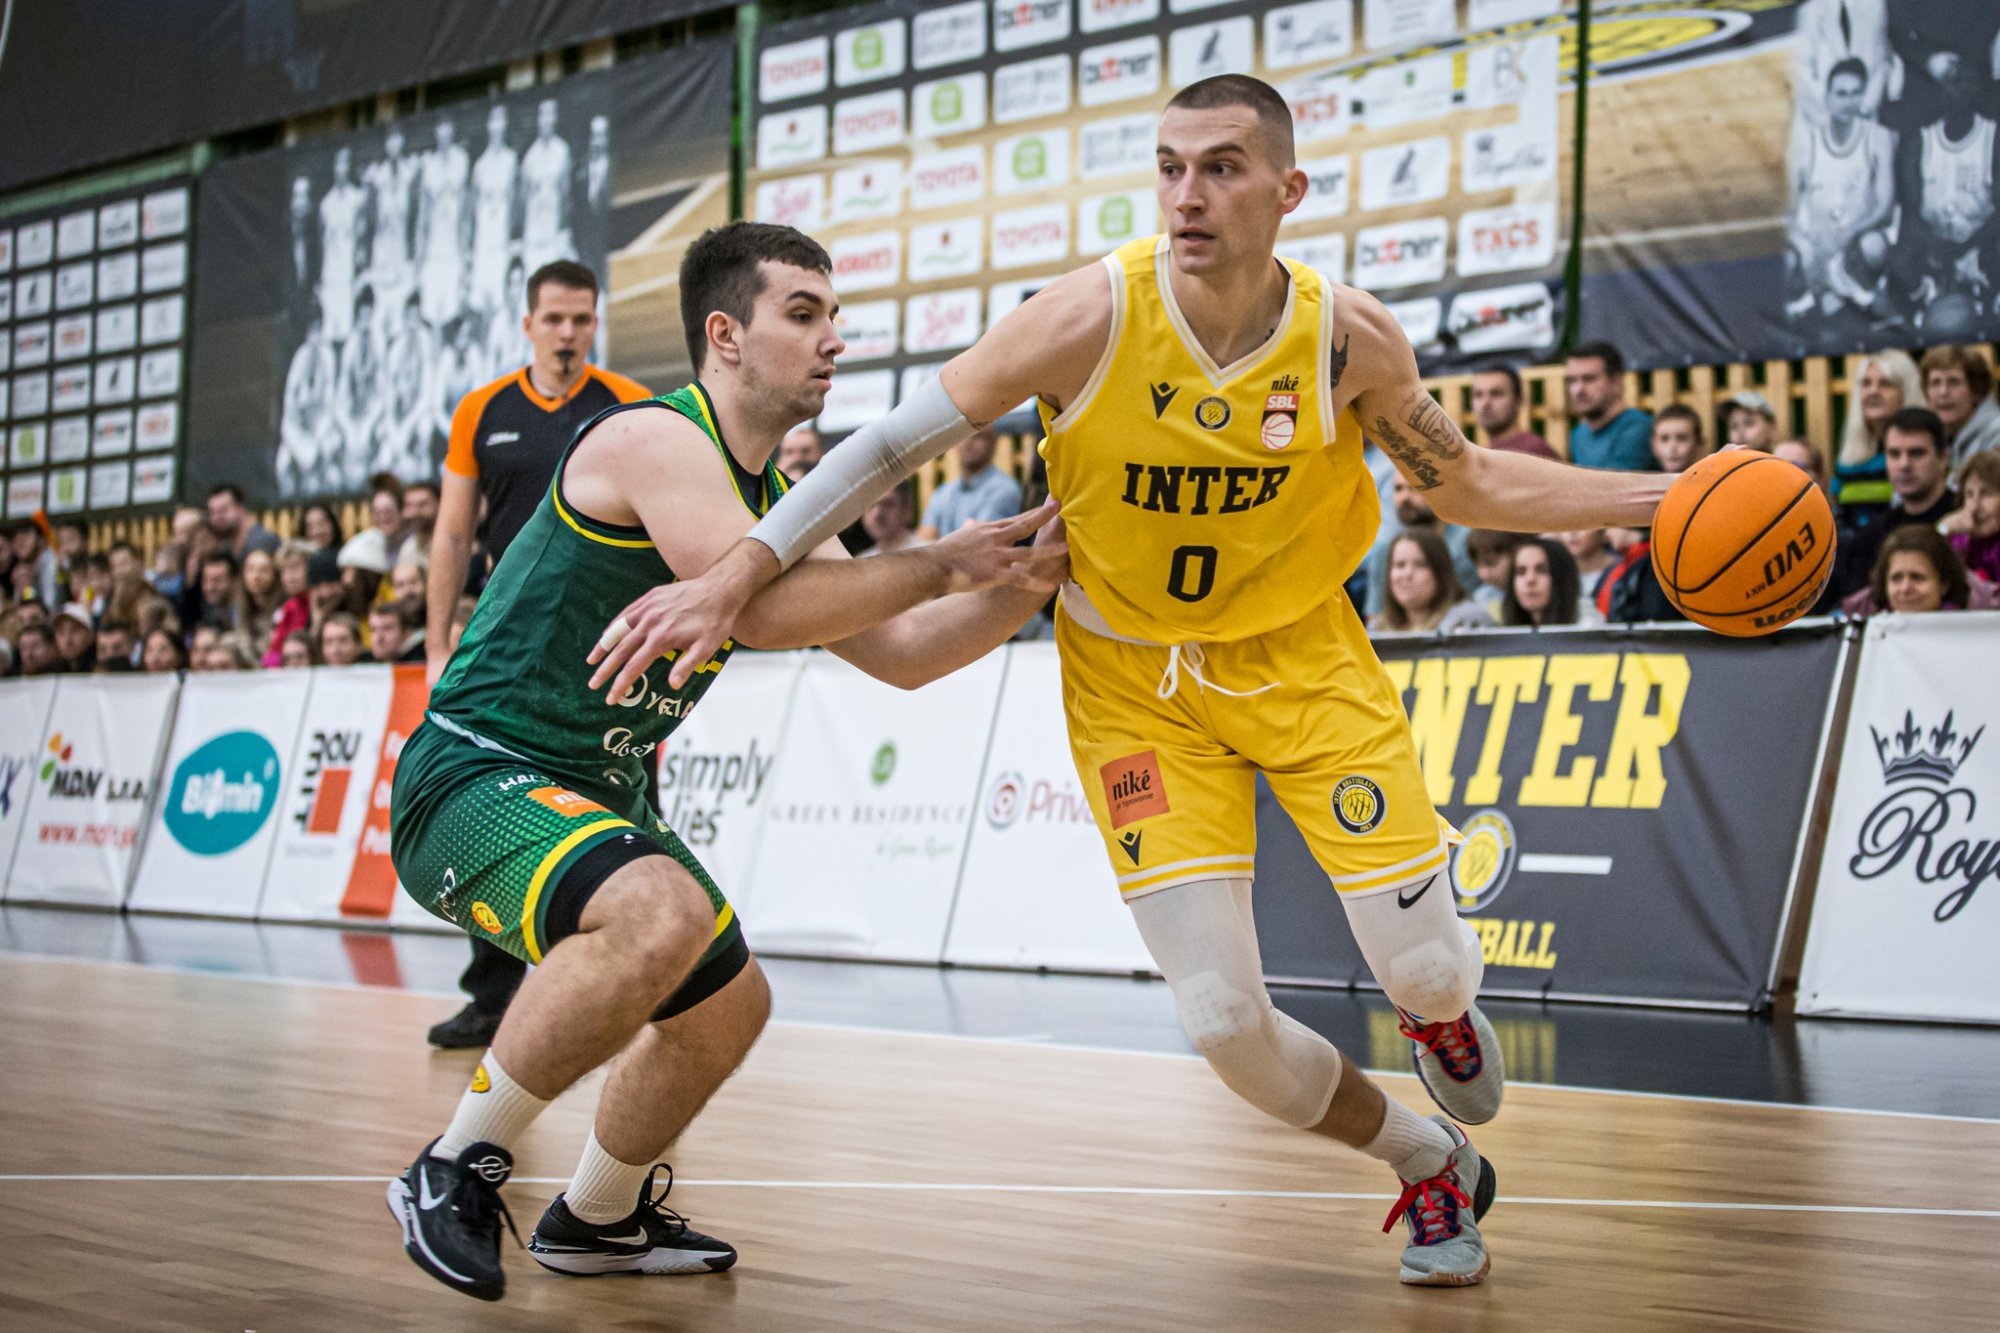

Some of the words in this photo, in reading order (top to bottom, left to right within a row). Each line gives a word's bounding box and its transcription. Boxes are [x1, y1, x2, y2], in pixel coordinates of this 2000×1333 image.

[915, 163, 979, 191] TOYOTA
[998, 221, 1062, 249] TOYOTA
[1267, 395, 1296, 409] SBL
[1271, 375, 1299, 391] niké
[1121, 462, 1291, 516] INTER
[1166, 545, 1218, 603] 0
[1763, 522, 1816, 587] EVO
[1745, 582, 1766, 600] NXT
[661, 738, 774, 809] simply
[1112, 769, 1151, 801] niké
[670, 794, 723, 846] lies
[1848, 786, 2000, 923] Roy
